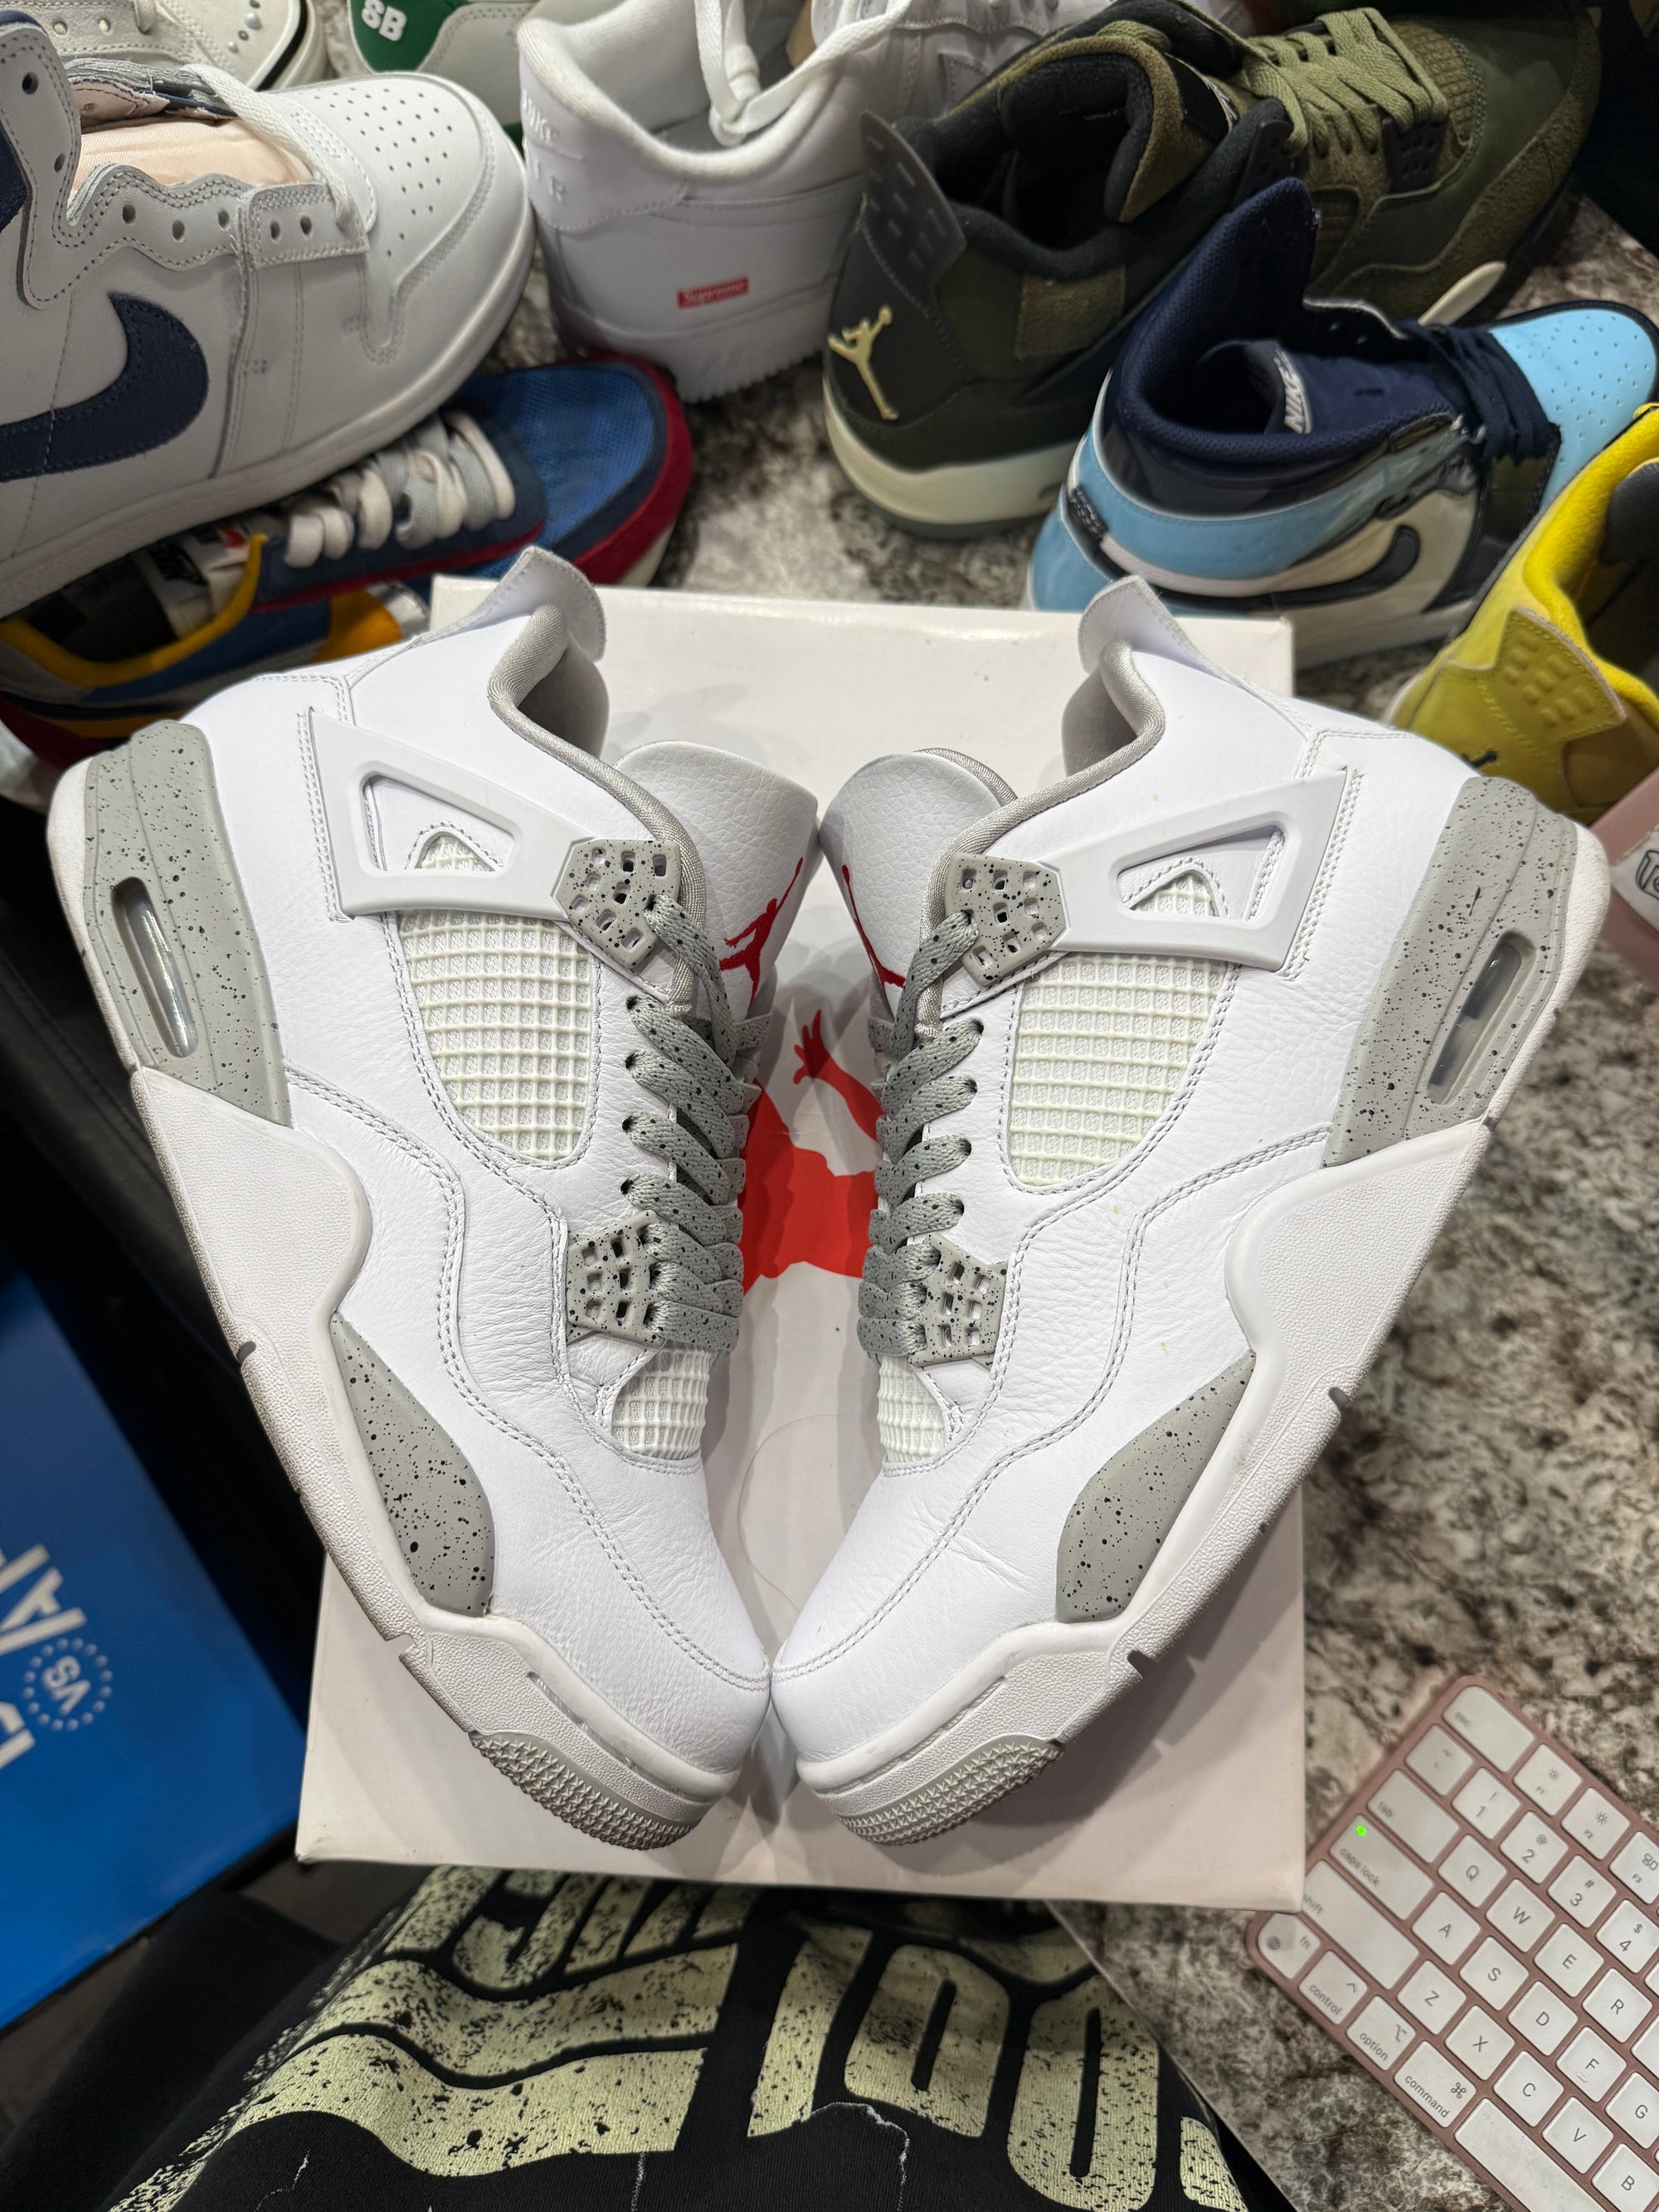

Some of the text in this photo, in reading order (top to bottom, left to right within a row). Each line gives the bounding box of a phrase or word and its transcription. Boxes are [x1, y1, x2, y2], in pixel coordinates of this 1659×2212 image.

[362, 0, 407, 41] SB
[43, 1655, 91, 1716] VS
[1377, 1800, 1394, 1818] tab
[1476, 1806, 1486, 1818] 1
[1584, 1830, 1593, 1840] F2
[1521, 1849, 1535, 1864] 2
[1339, 1847, 1380, 1887] caps lock
[1465, 1864, 1479, 1882] Q
[1584, 1879, 1595, 1889] #
[1632, 1874, 1642, 1884] F3
[1569, 1893, 1583, 1907] 3
[1512, 1906, 1531, 1925] W
[1438, 1923, 1452, 1938] A
[1633, 1923, 1643, 1934] $
[1299, 1935, 1311, 1949] fn
[1619, 1939, 1632, 1952] 4
[1562, 1953, 1578, 1970] E
[1487, 1966, 1501, 1982] S
[1308, 1984, 1342, 2016] control
[1424, 1990, 1440, 2007] Z
[1610, 1998, 1625, 2015] R
[1535, 2011, 1550, 2026] D
[1359, 2032, 1389, 2062] option
[1472, 2035, 1489, 2053] X
[1585, 2058, 1600, 2070] F
[1404, 2075, 1451, 2118] command
[1522, 2083, 1536, 2098] C
[1634, 2104, 1648, 2119] G
[1573, 2127, 1587, 2143] V
[1621, 2175, 1635, 2191] B
